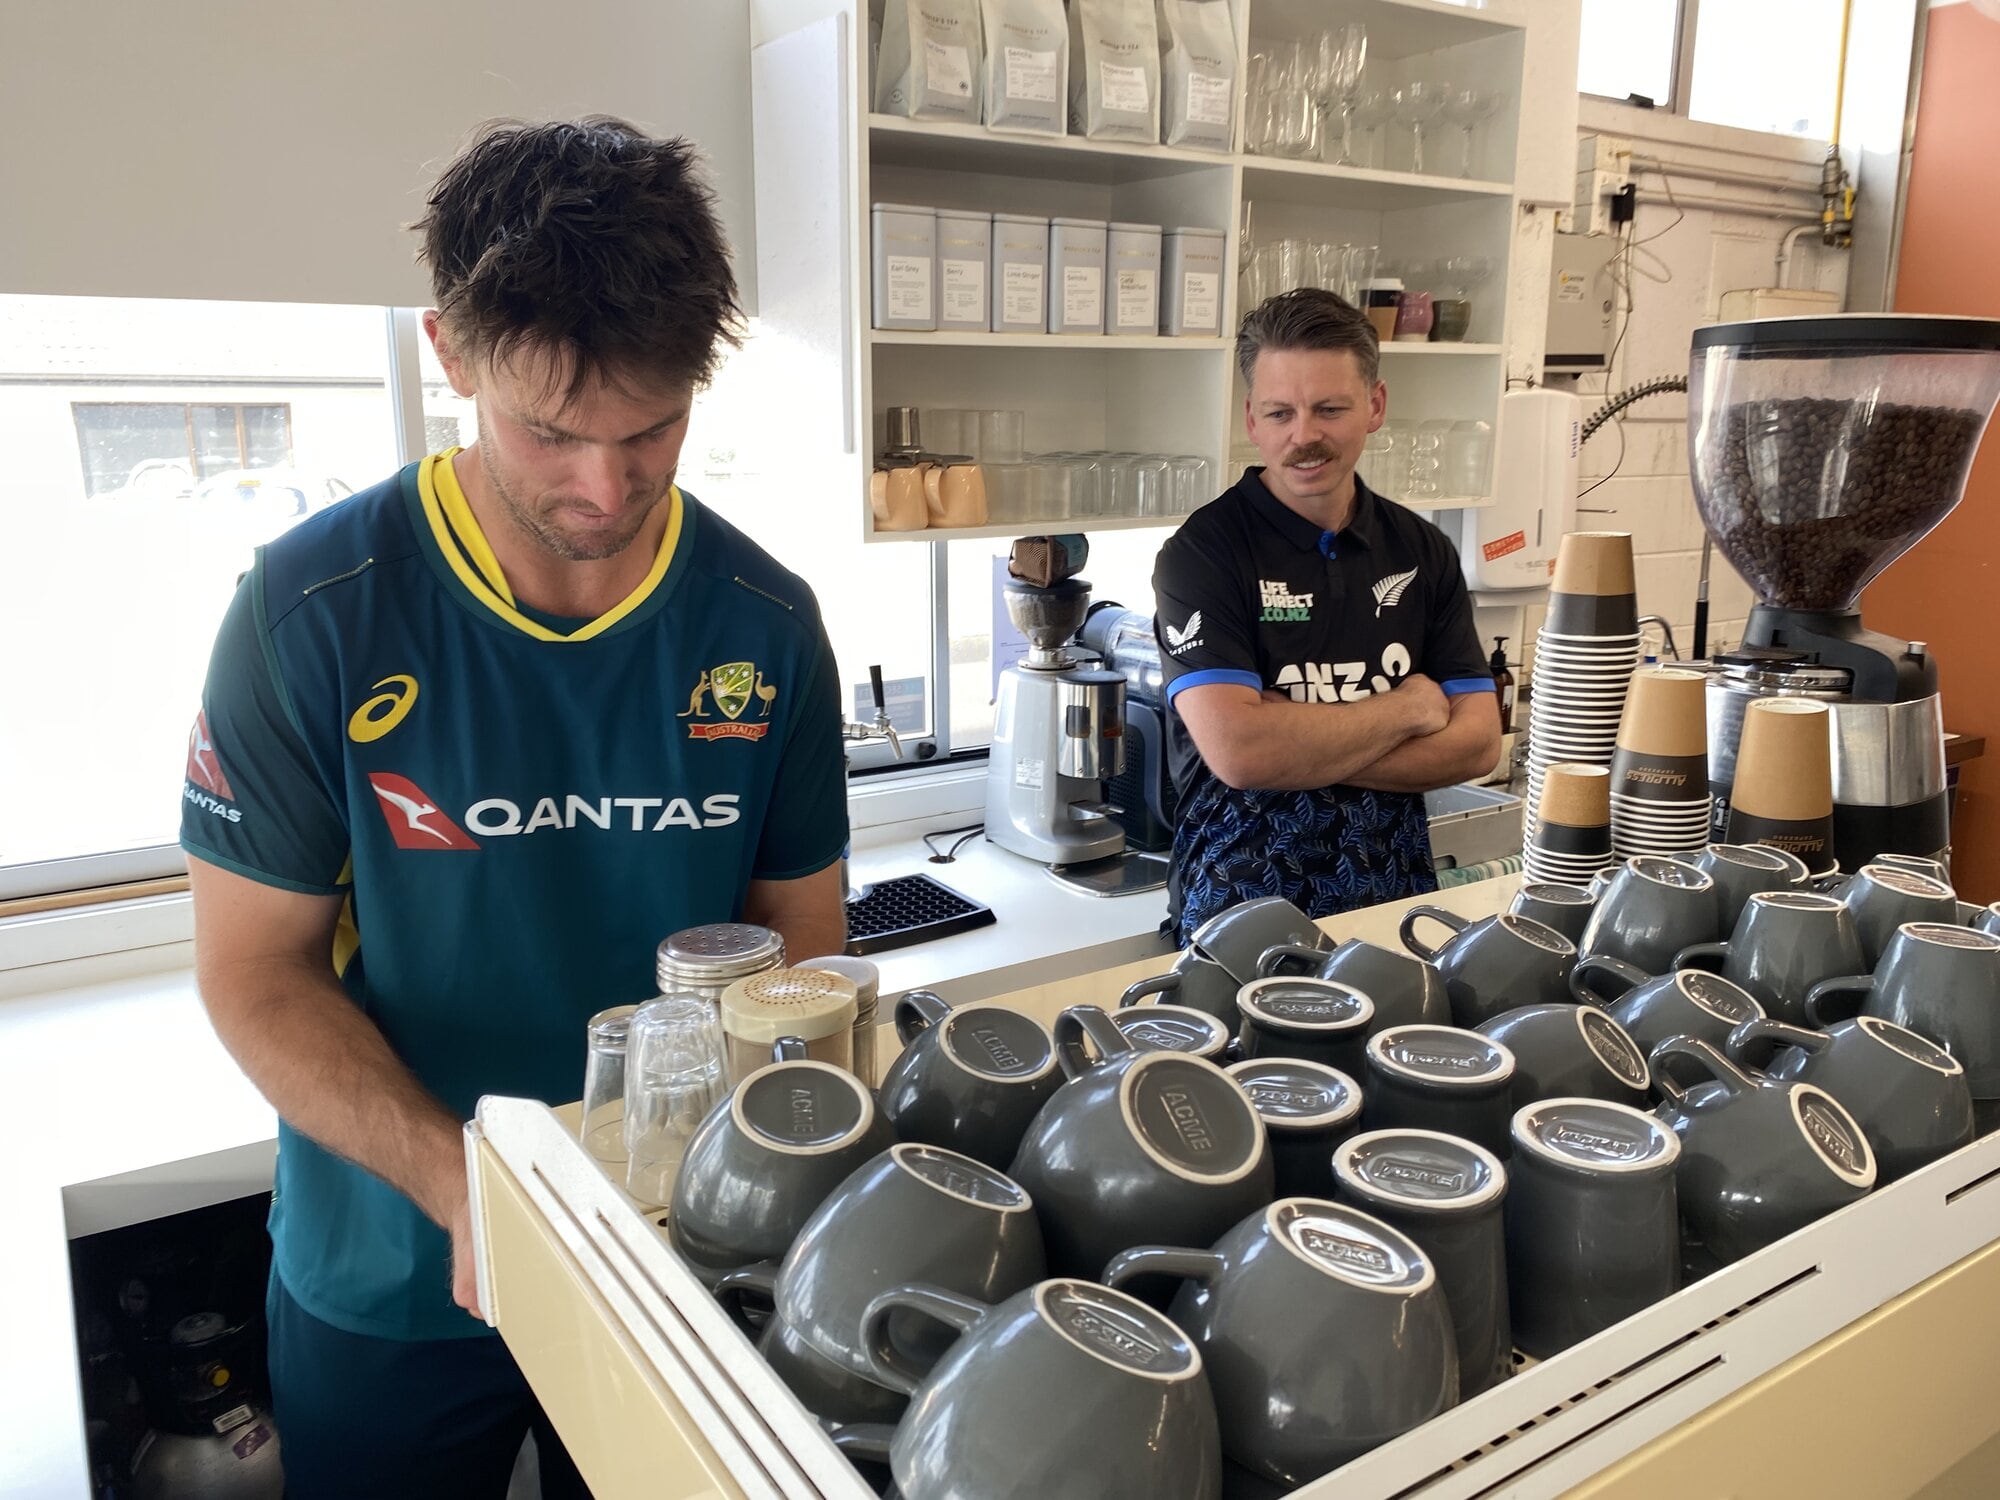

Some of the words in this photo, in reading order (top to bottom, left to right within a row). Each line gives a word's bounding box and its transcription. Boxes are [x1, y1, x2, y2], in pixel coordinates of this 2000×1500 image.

[891, 264, 904, 273] Earl
[905, 265, 920, 274] Grey
[1006, 271, 1022, 279] Lime
[1258, 579, 1290, 595] LIFE
[1261, 593, 1314, 608] DIRECT
[1259, 607, 1311, 622] .CO.NZ
[1270, 661, 1372, 704] ANZ
[706, 724, 760, 737] AUSTRALIA
[1625, 769, 1687, 787] ALLPRESS
[463, 793, 741, 837] QANTAS
[791, 1089, 815, 1133] ACME
[1164, 1091, 1212, 1151] ACME
